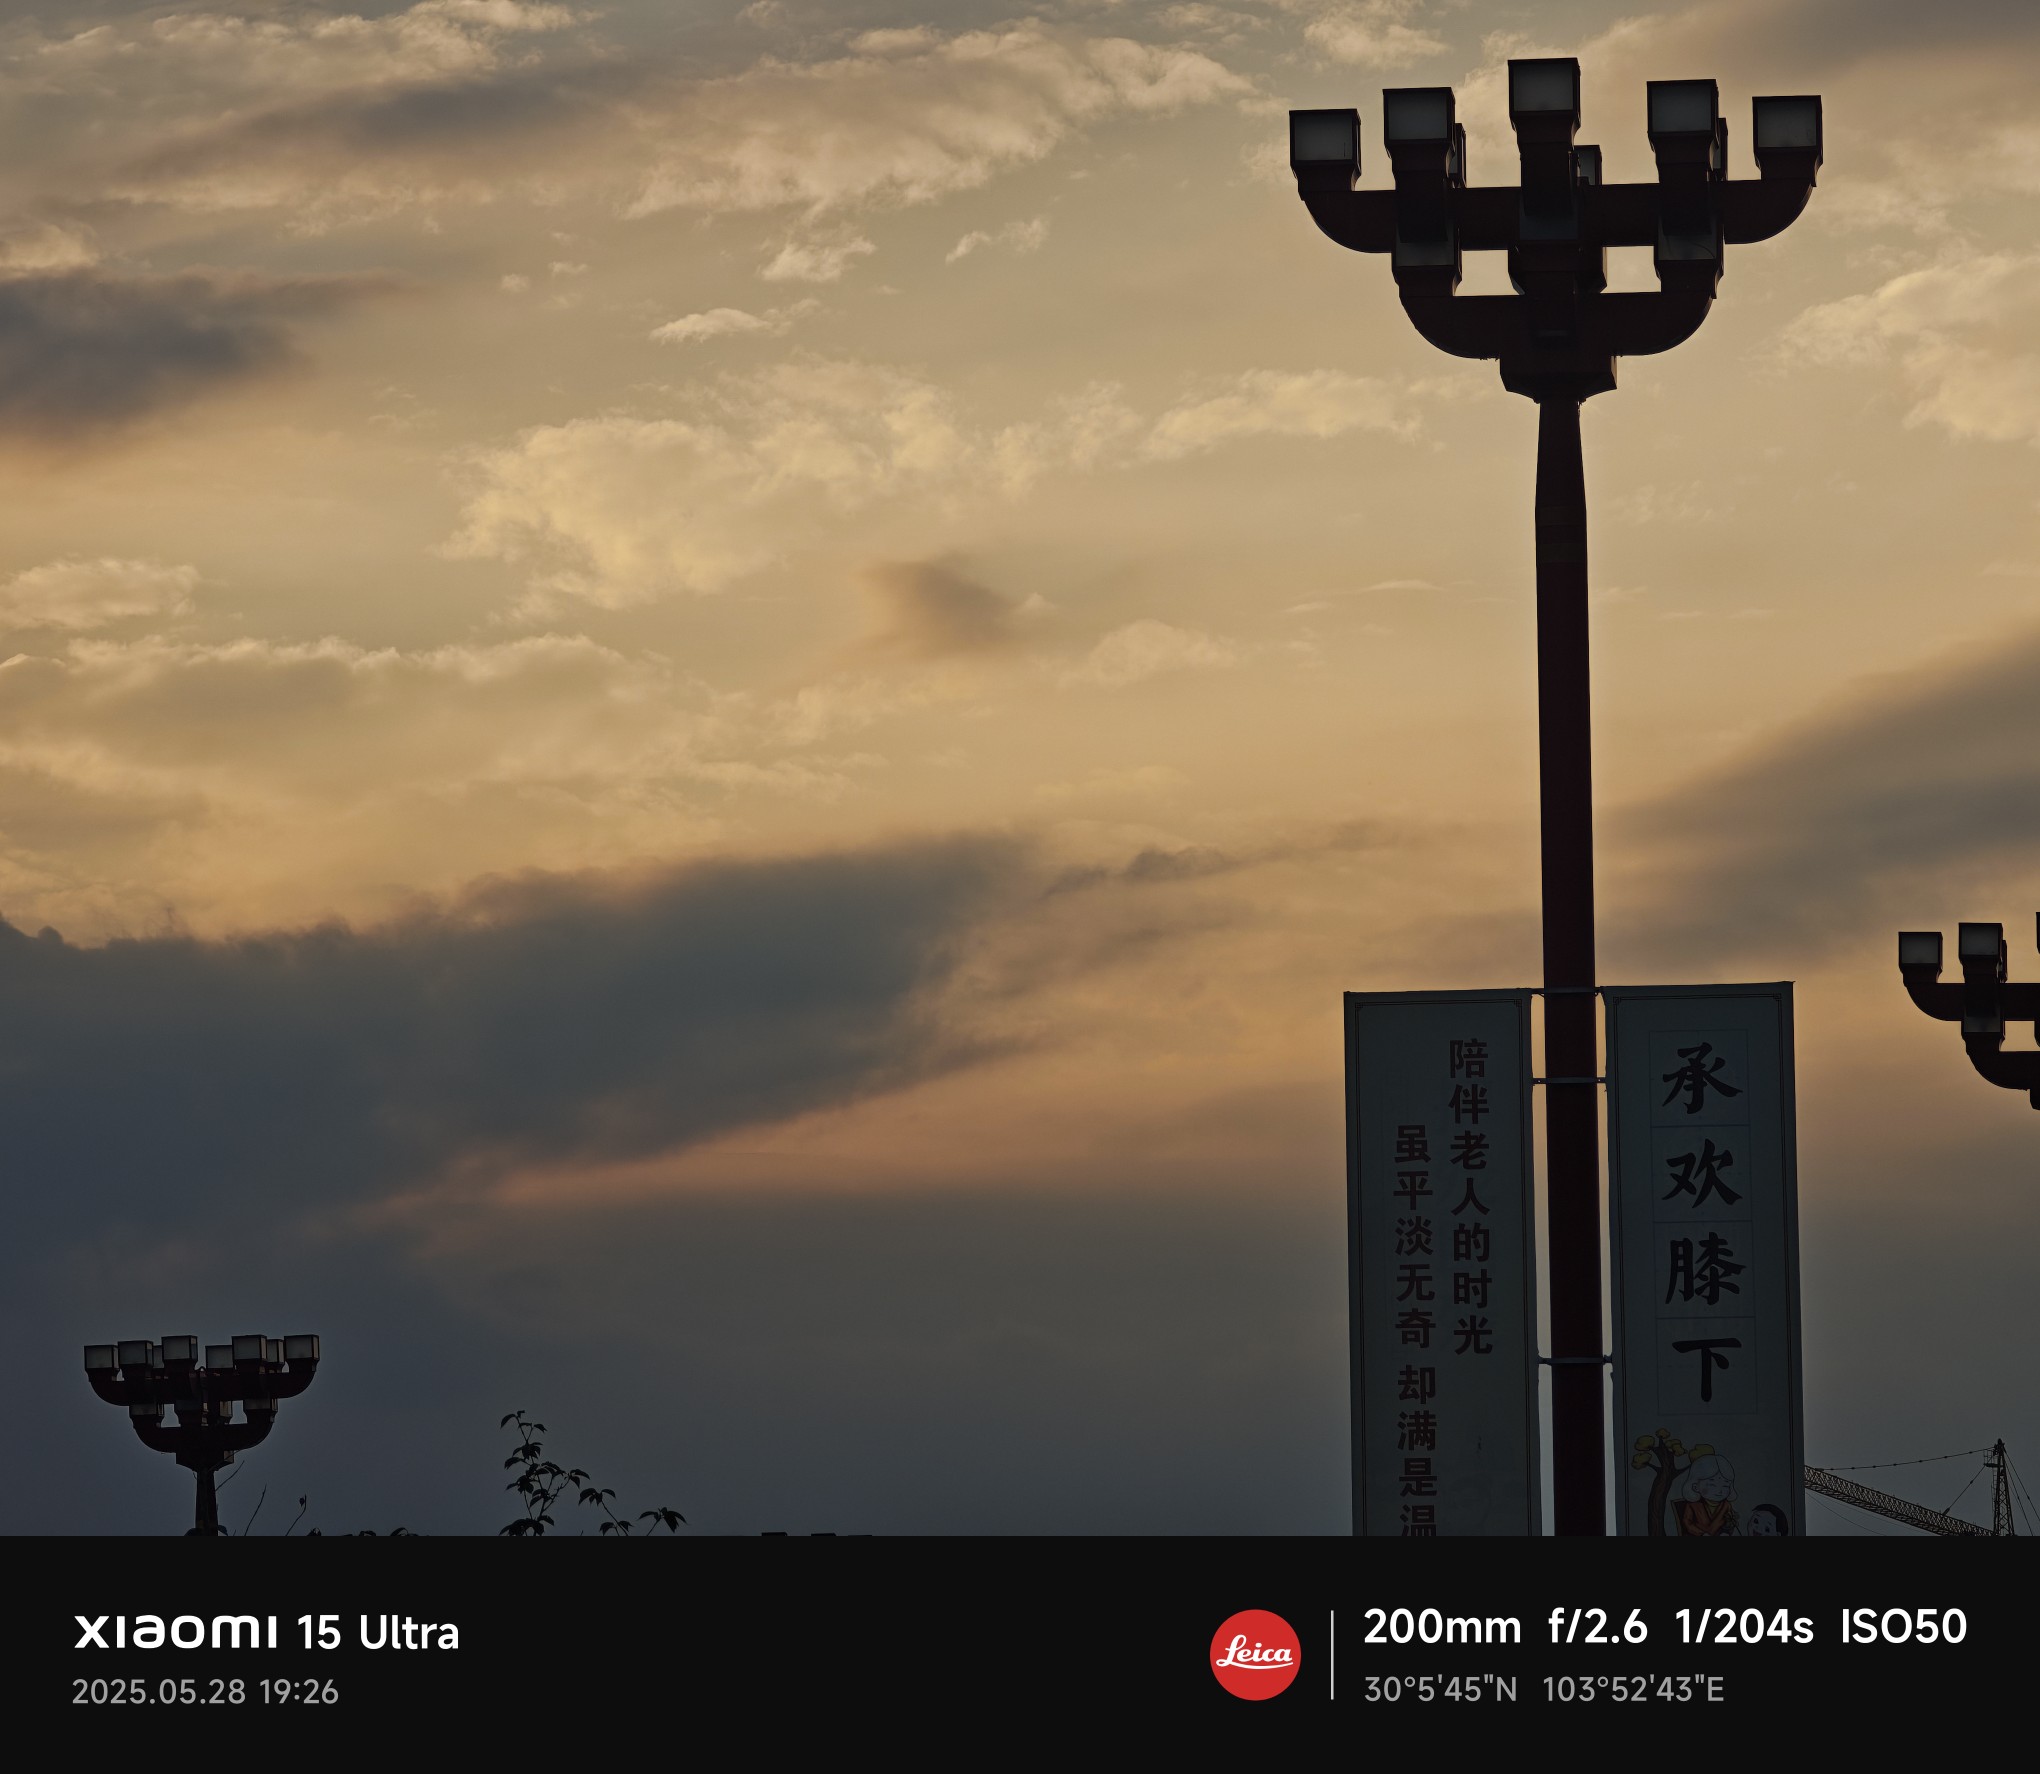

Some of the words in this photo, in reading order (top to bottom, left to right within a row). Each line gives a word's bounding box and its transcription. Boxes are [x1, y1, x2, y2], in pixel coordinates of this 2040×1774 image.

[1393, 1124, 1437, 1349] 虽平淡无奇
[1448, 1038, 1493, 1355] 陪伴老人的时光
[1662, 1042, 1747, 1403] 承欢膝下
[1397, 1364, 1438, 1537] 却满是温
